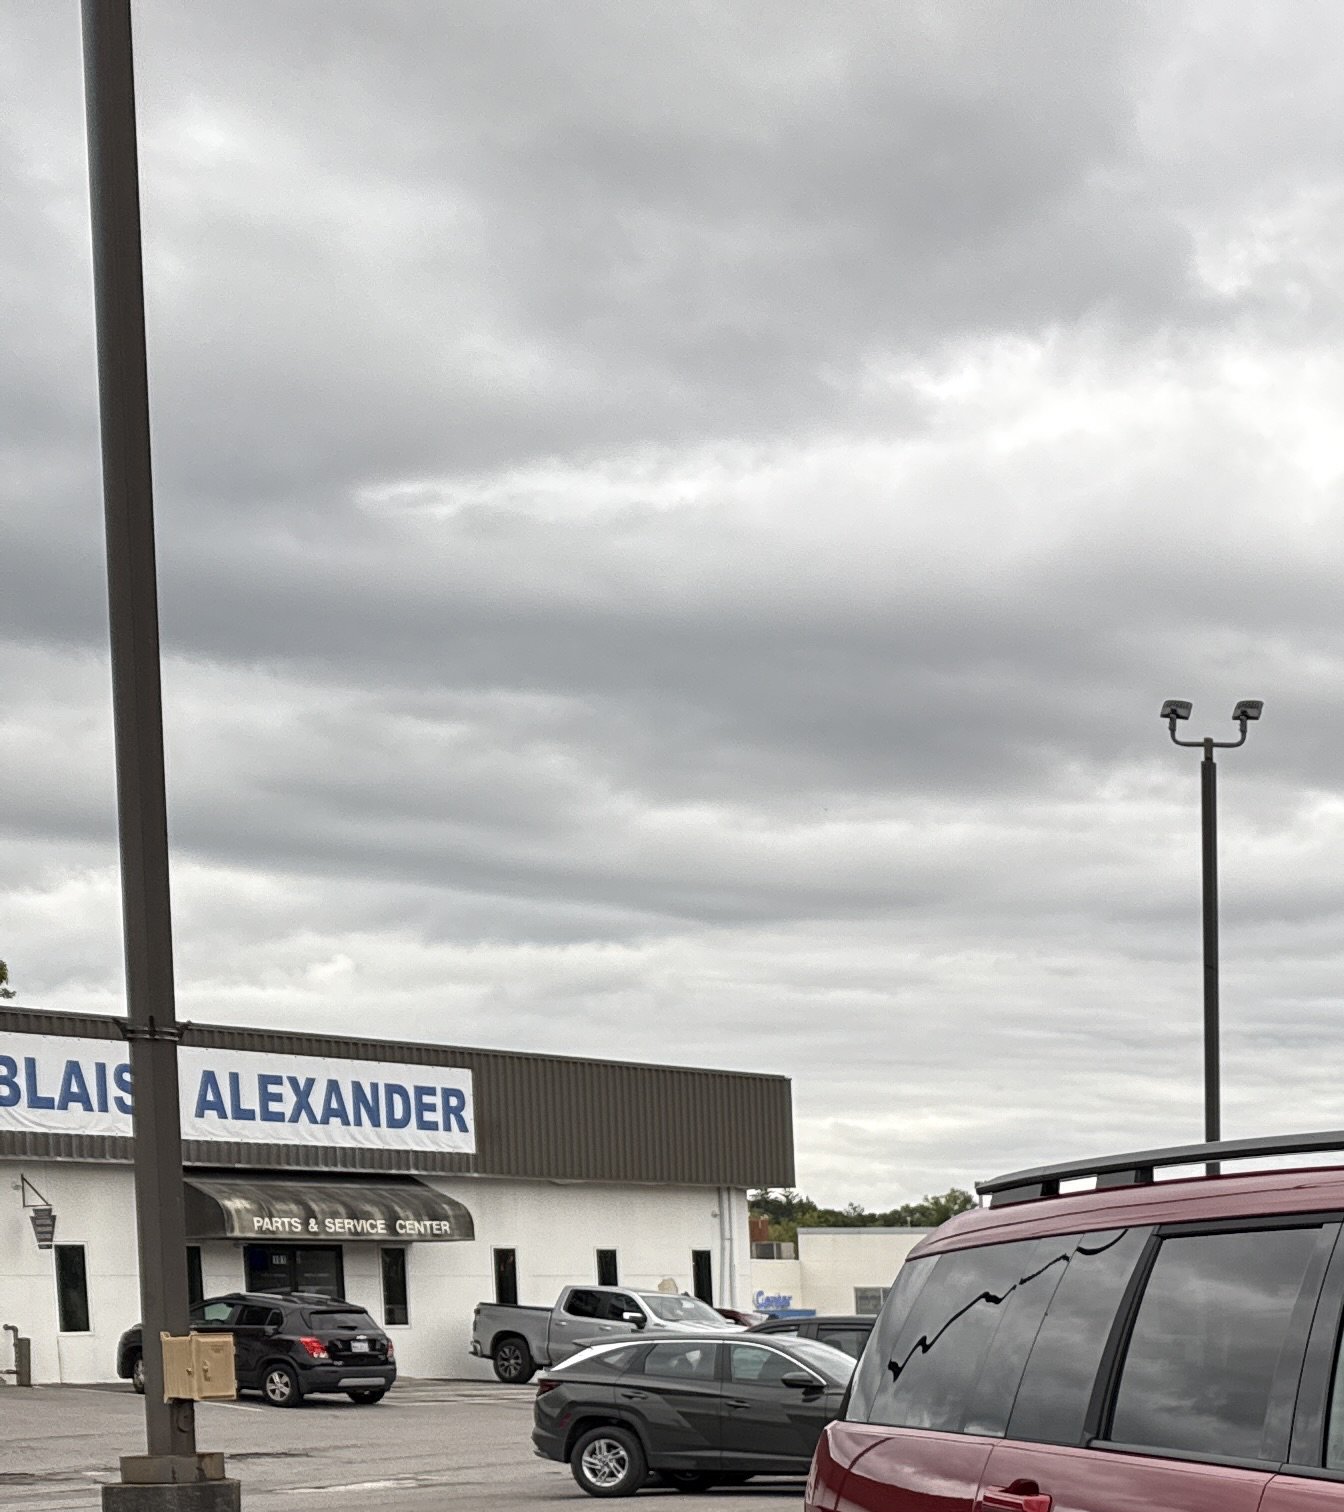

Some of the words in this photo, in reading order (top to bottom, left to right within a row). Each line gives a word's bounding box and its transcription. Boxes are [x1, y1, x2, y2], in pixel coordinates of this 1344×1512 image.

[0, 1054, 134, 1116] BLAIS
[194, 1068, 470, 1134] ALEXANDER
[253, 1217, 302, 1233] PARTS
[308, 1218, 319, 1233] &
[325, 1218, 387, 1234] SERVICE
[395, 1220, 451, 1235] CENTER
